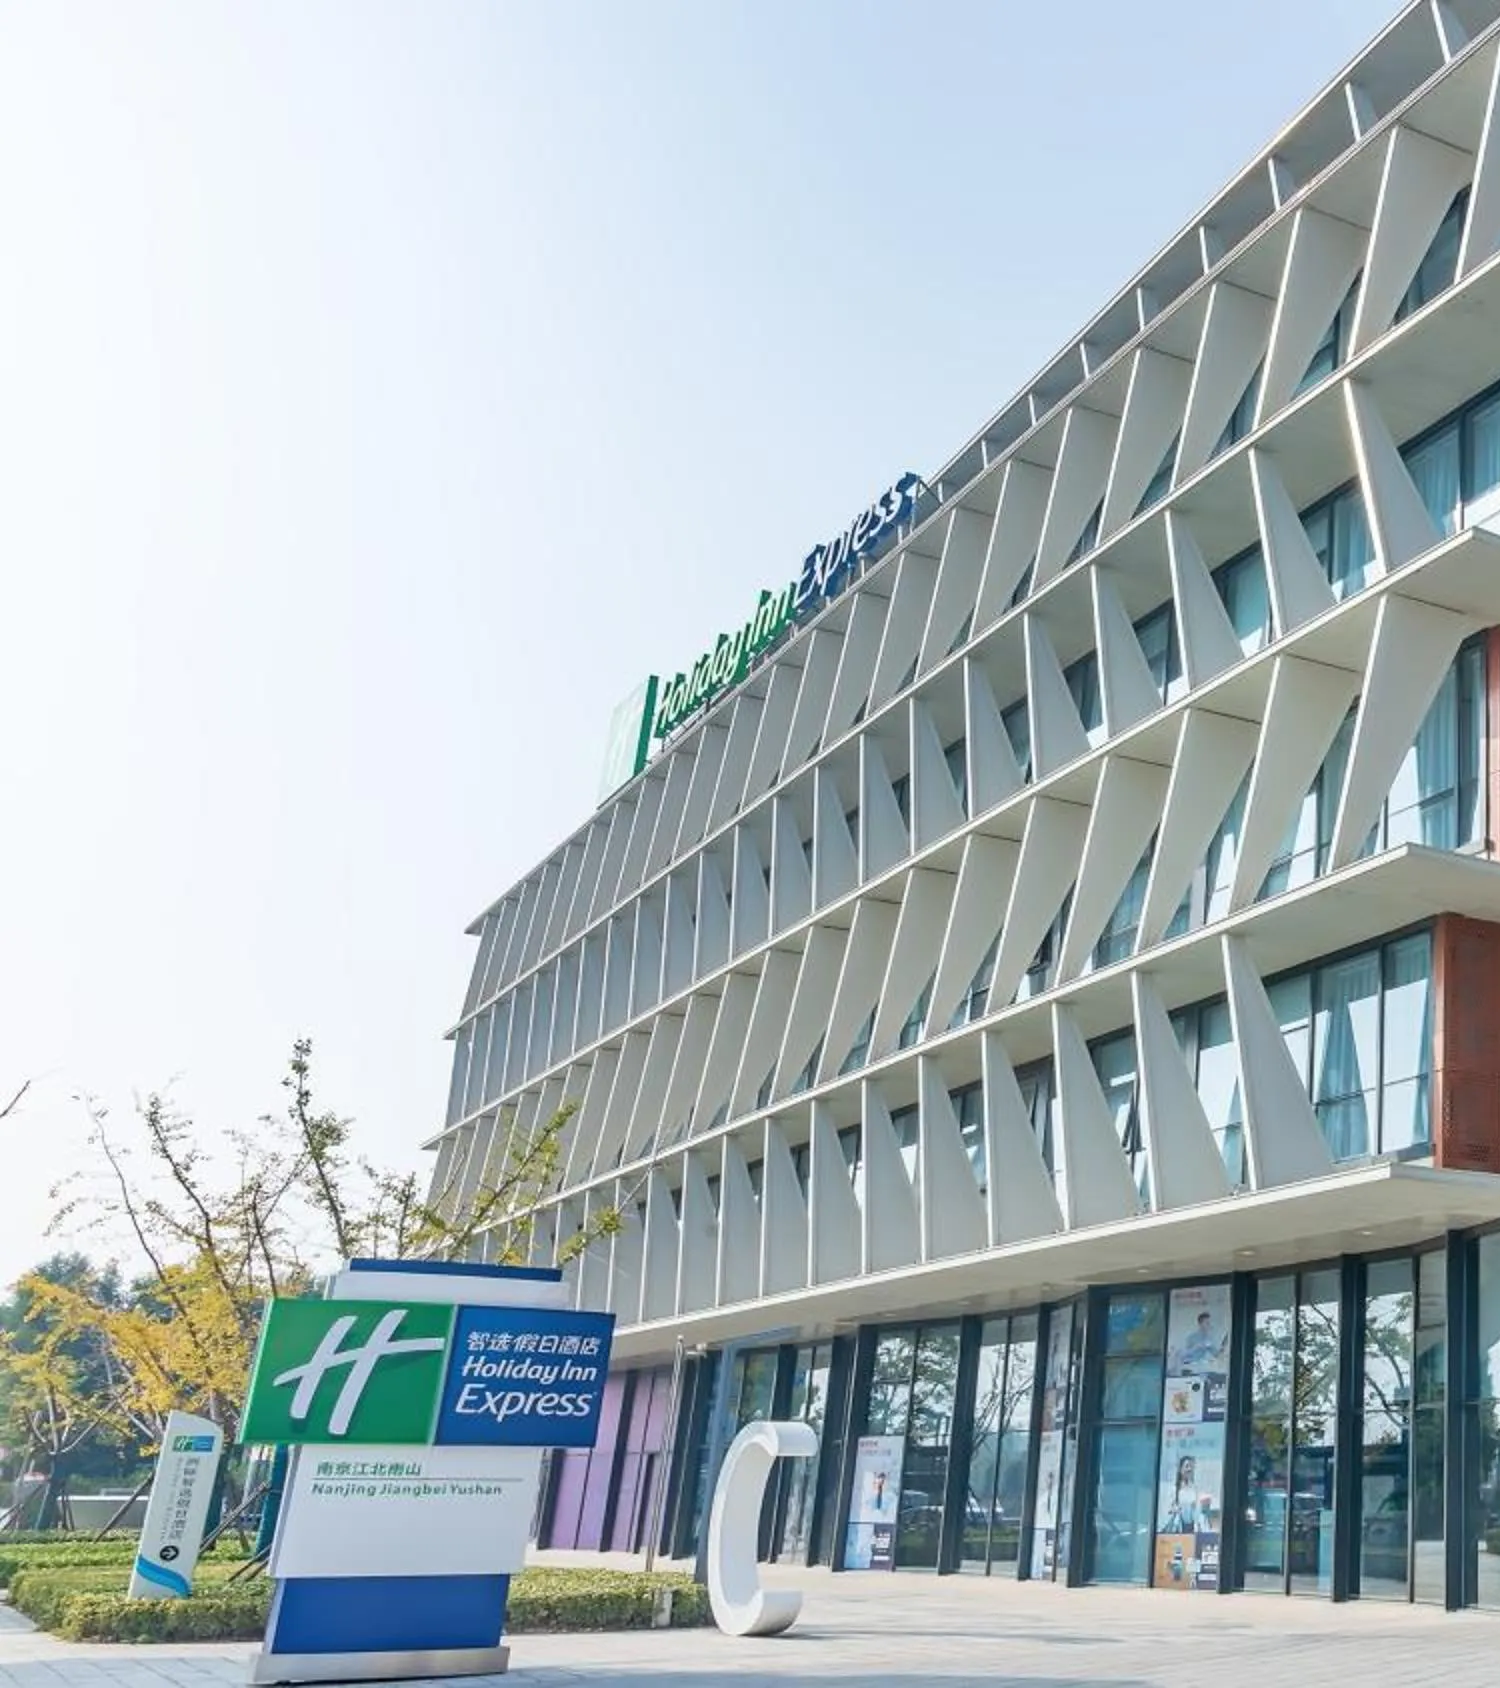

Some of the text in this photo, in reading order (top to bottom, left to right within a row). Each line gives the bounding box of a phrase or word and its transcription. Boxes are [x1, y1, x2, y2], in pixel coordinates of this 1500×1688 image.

[654, 632, 744, 739] Holiday
[793, 471, 920, 612] Express
[467, 1331, 601, 1356] 智选假日酒店
[461, 1355, 598, 1385] Holiday Inn
[455, 1383, 593, 1423] Express
[311, 1483, 503, 1497] Nanjing Jiangbei Yushan
